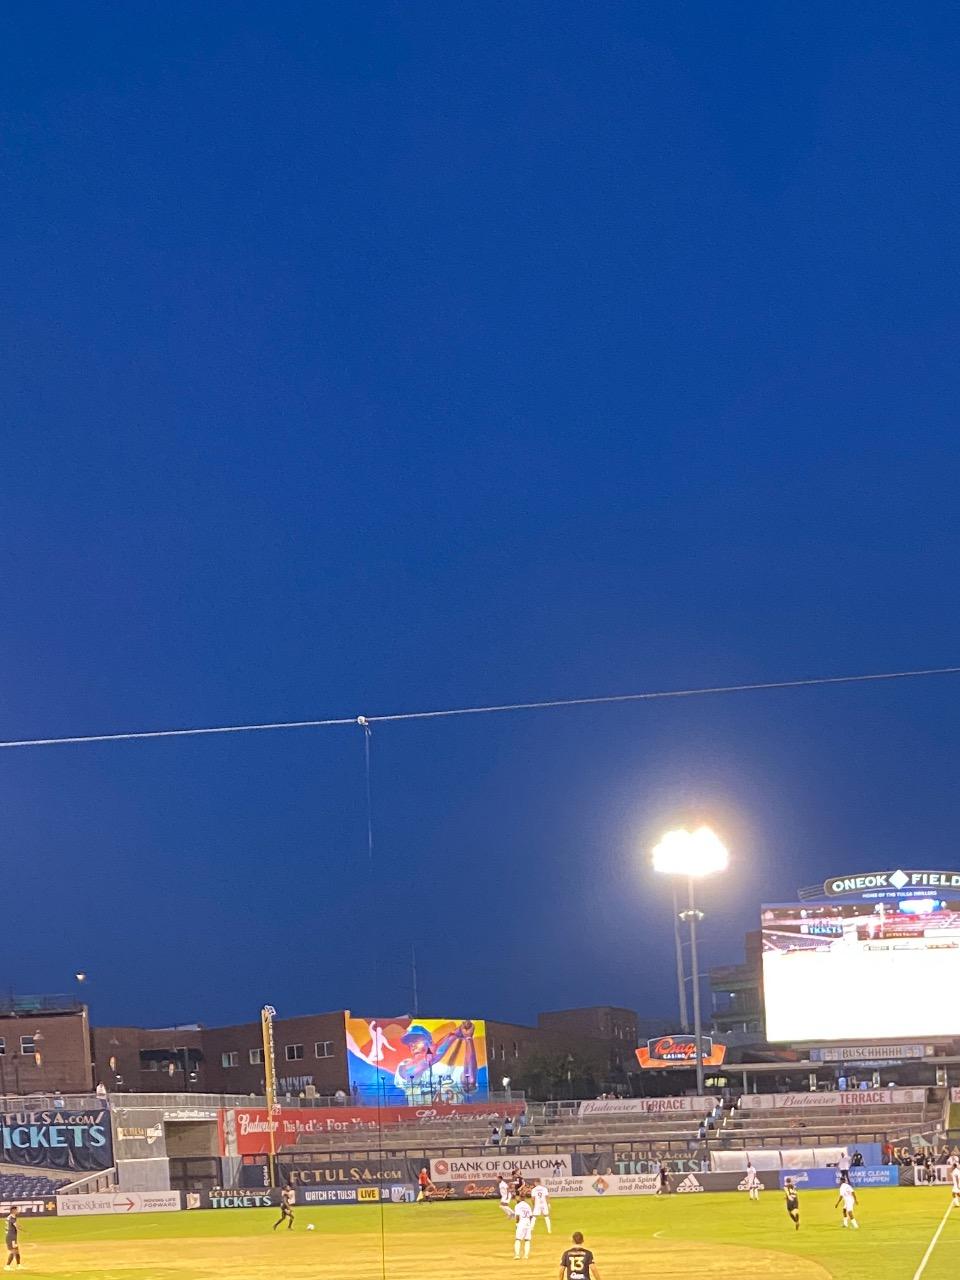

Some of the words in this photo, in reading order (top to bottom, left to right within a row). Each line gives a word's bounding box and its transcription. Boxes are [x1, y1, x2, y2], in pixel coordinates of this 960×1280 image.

[832, 874, 887, 892] ONEOK
[840, 1092, 885, 1104] TERRACE
[641, 1100, 686, 1112] TERRACE
[326, 1118, 349, 1131] For
[0, 1126, 106, 1149] ICKETS
[450, 1161, 483, 1173] BANK
[485, 1160, 501, 1171] OF
[502, 1158, 567, 1171] OKLAHOMA
[450, 1172, 467, 1180] LONG
[637, 1175, 657, 1184] Spine
[564, 1178, 583, 1187] Spine
[635, 1184, 657, 1192] Rehab
[305, 1191, 327, 1201] WATCH
[328, 1191, 336, 1200] FC
[337, 1190, 356, 1200] TULSA
[360, 1189, 377, 1199] LIVE
[537, 1191, 543, 1200] 9
[561, 1186, 584, 1194] Rehab
[209, 1196, 272, 1209] TICKETS
[568, 1256, 585, 1272] 13
